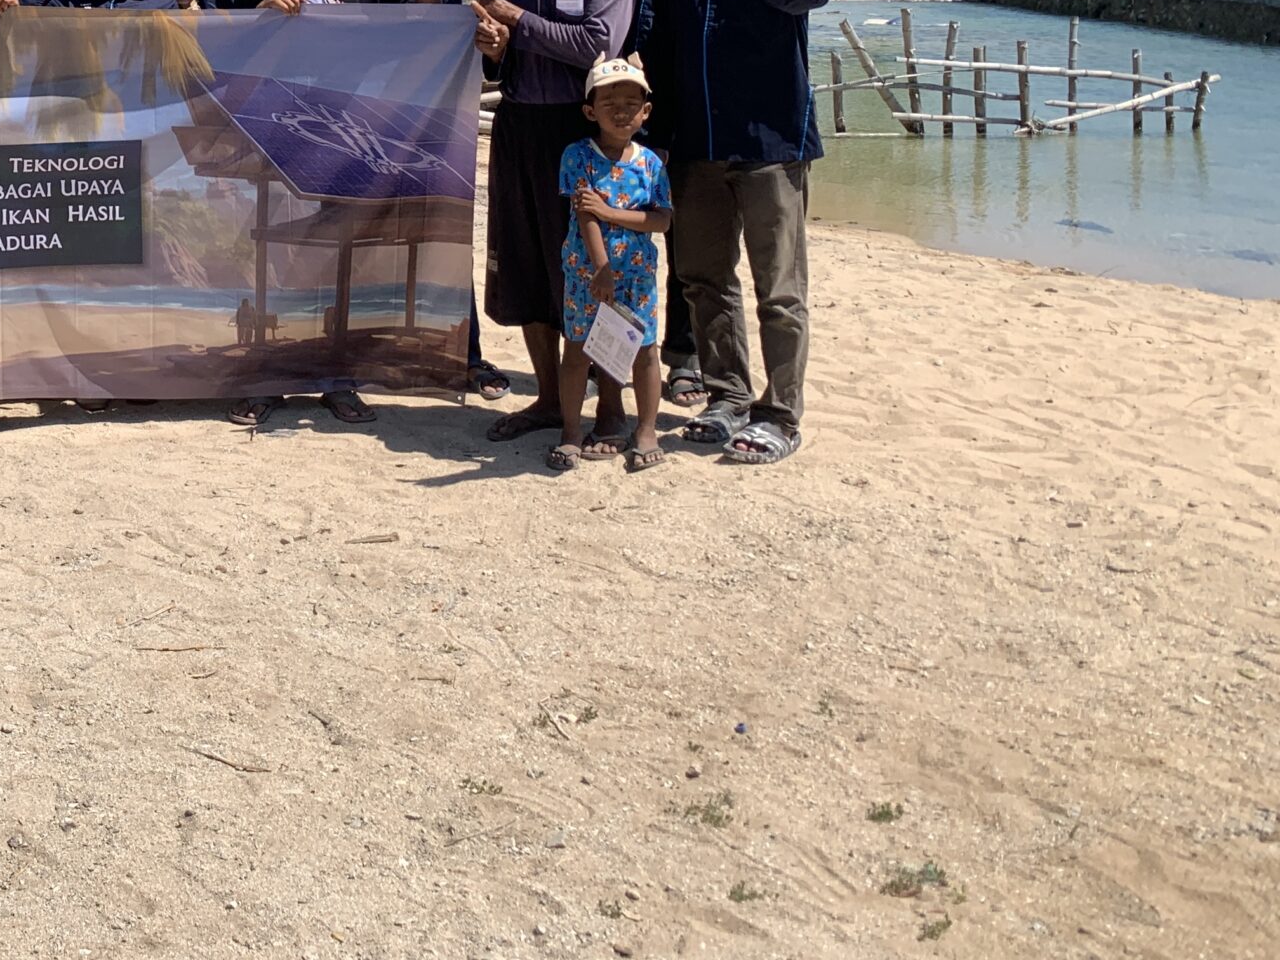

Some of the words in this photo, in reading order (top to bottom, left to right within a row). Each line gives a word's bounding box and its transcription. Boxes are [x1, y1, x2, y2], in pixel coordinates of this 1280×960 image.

[10, 155, 125, 174] TEKNOLOGI
[60, 179, 125, 197] UPAYA
[1, 208, 51, 226] IKAN
[67, 205, 126, 222] HASIL
